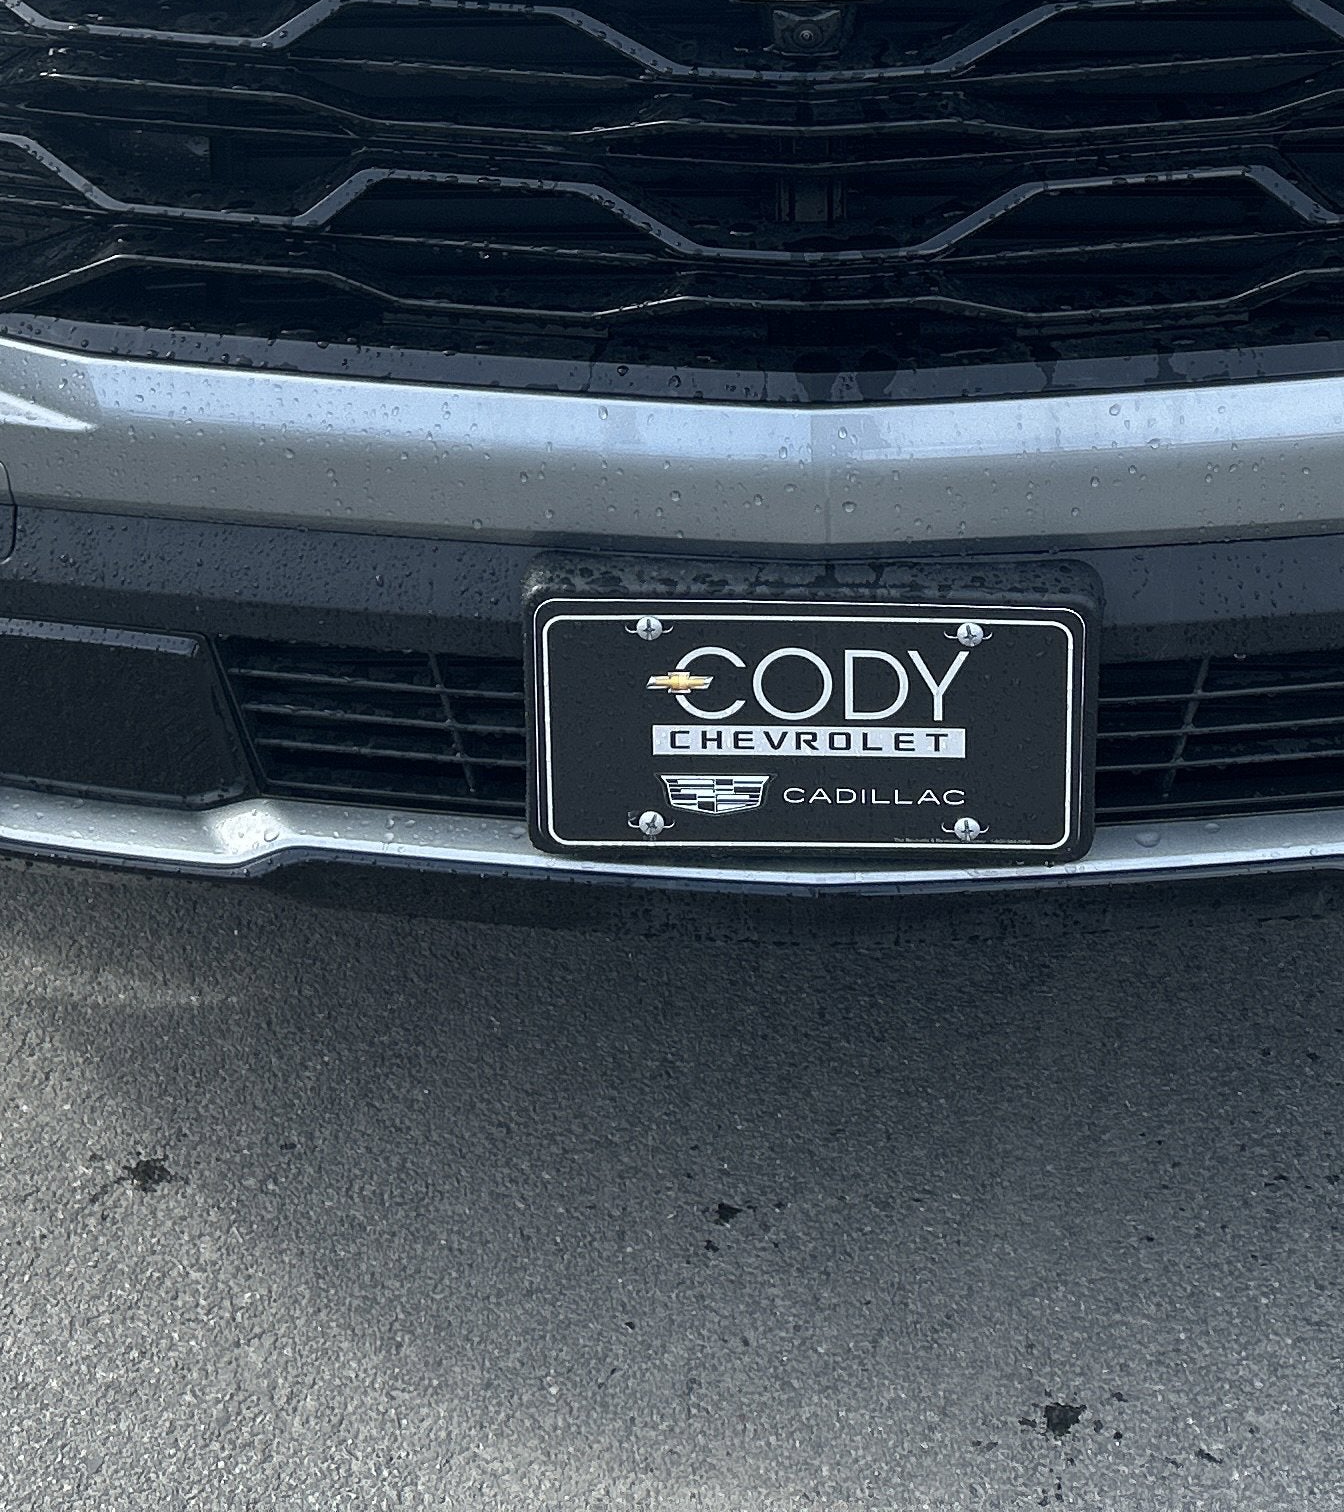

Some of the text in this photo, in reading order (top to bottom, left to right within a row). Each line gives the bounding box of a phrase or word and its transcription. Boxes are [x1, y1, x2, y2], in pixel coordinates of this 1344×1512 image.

[675, 645, 970, 722] CODY
[669, 730, 949, 753] CHEVROLET
[782, 787, 966, 806] CADILLAC
